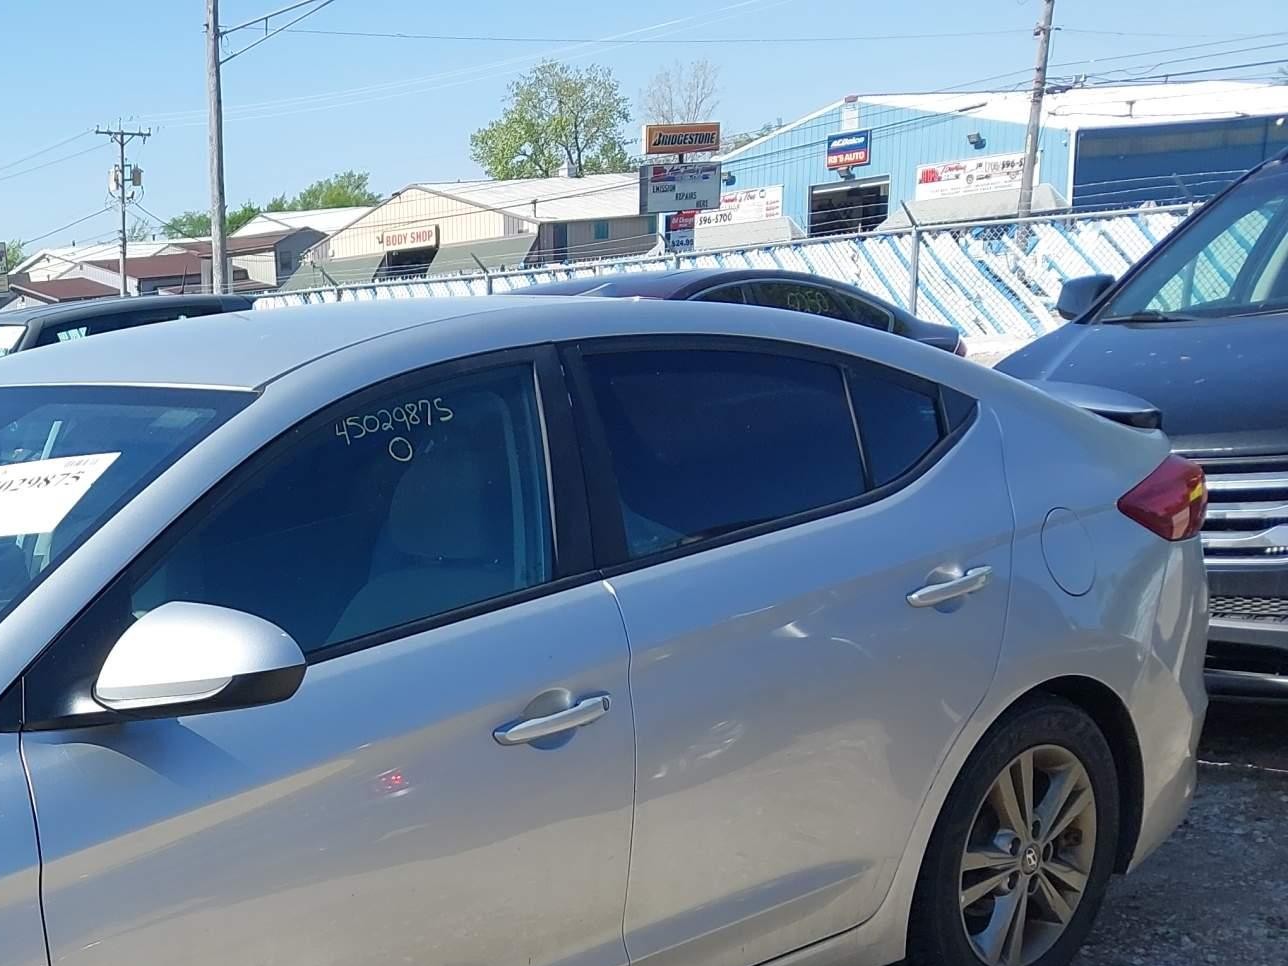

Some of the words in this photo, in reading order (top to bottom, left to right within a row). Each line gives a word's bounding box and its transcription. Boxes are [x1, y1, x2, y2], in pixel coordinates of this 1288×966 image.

[653, 132, 716, 146] BRIDGESTONE
[844, 151, 865, 162] AUTO
[675, 191, 697, 201] REPAIRS
[695, 199, 709, 208] HERE
[385, 233, 408, 246] BODY
[410, 230, 433, 243] SHOP
[335, 398, 454, 446] 45029875
